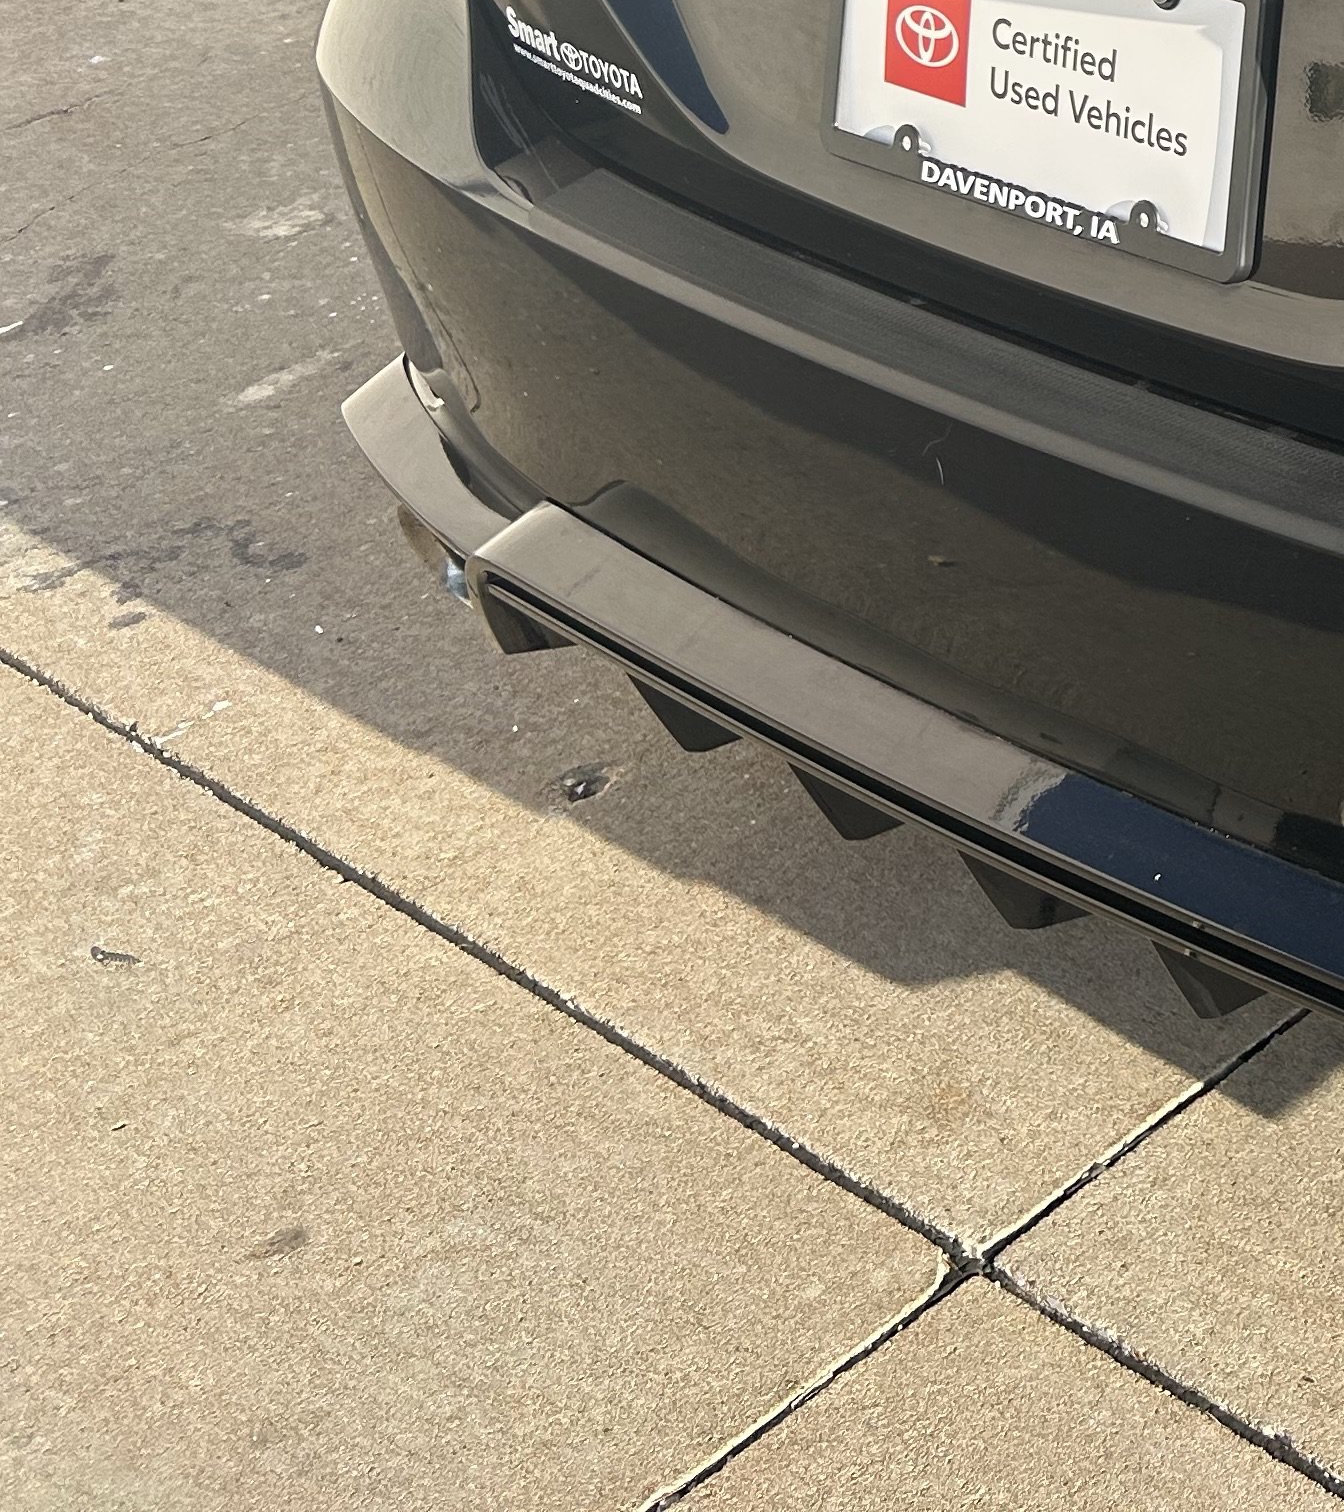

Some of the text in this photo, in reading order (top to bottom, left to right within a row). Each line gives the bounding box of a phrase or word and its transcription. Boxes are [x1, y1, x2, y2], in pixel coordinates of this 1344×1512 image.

[505, 5, 644, 100] Smart TOYOTA
[991, 17, 1118, 83] Certified
[989, 66, 1189, 157] Used Vehicles
[920, 160, 1121, 245] DAVENPORT, IA
